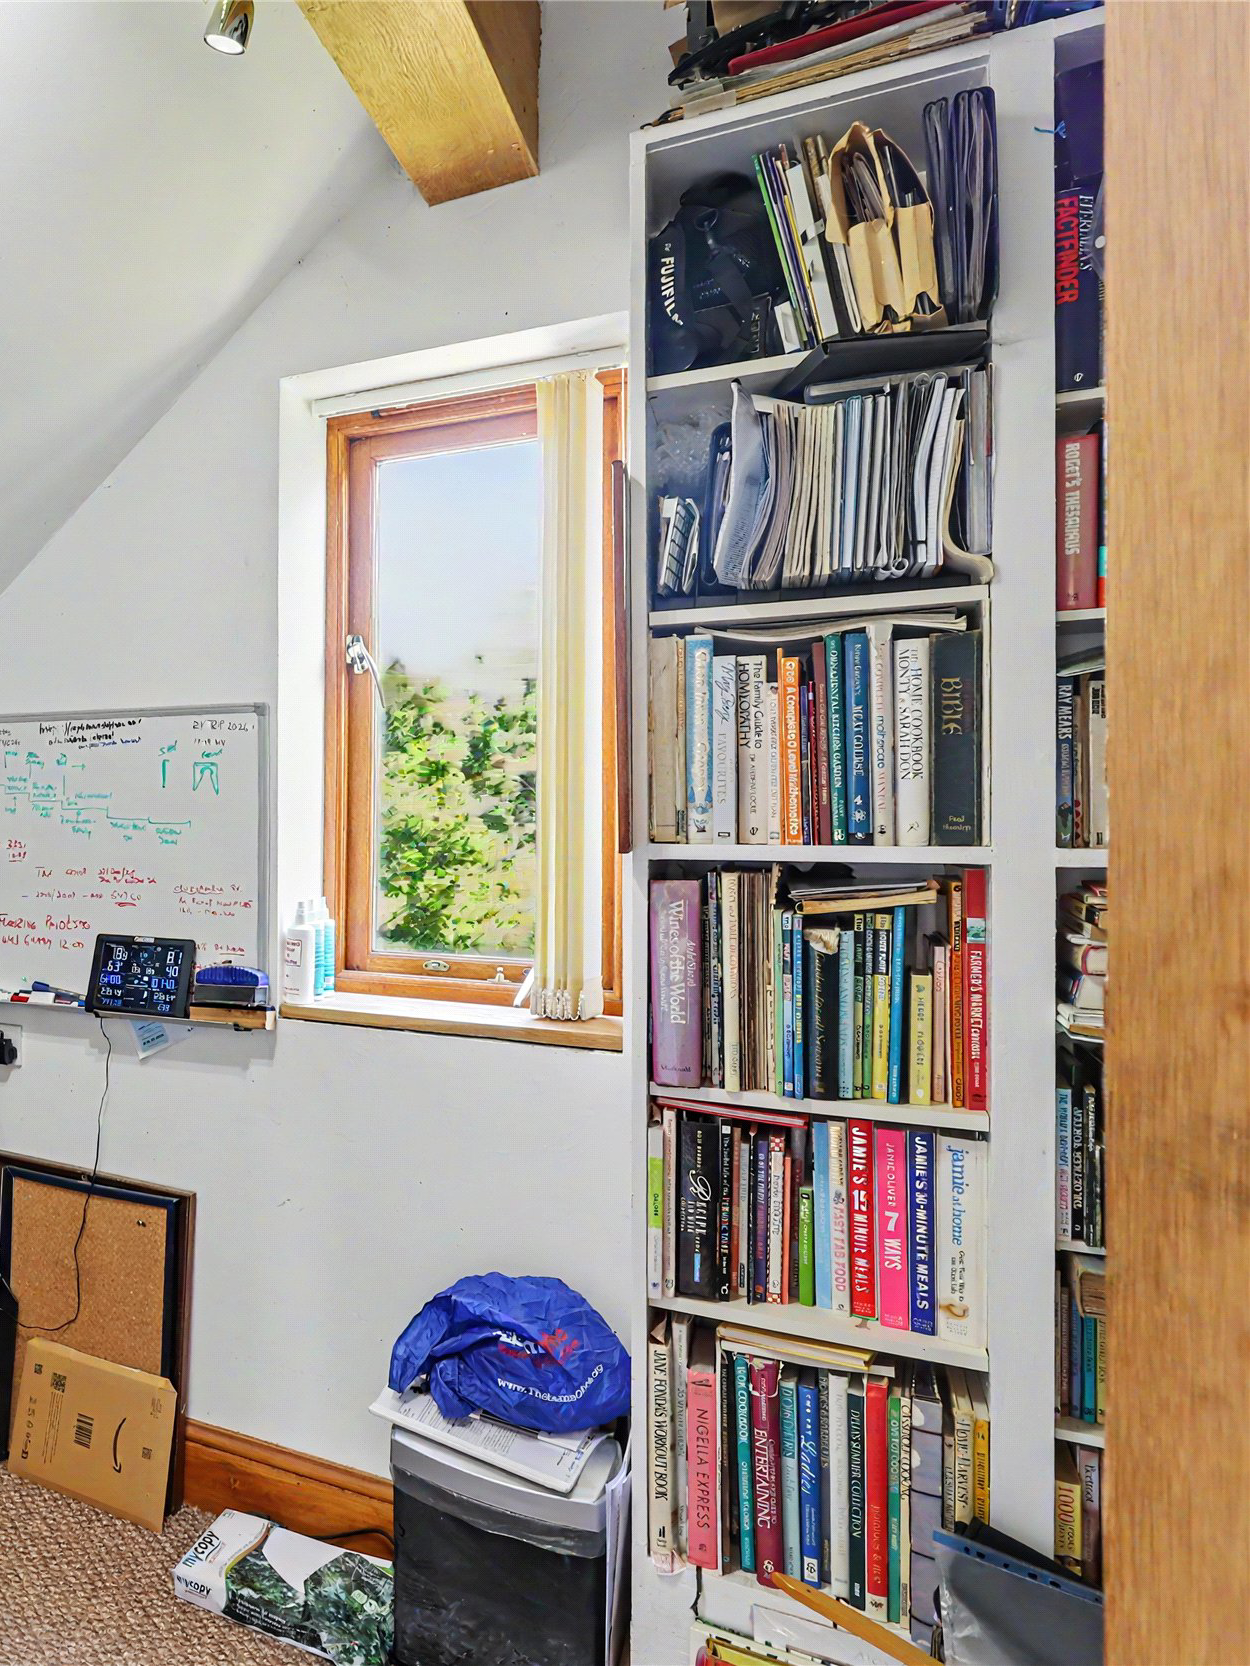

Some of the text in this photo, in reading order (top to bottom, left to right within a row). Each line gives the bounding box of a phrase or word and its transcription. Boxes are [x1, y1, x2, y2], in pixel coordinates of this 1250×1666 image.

[1055, 195, 1079, 305] FACTFINDER
[1065, 443, 1082, 555] ROGET'S THESAURUS
[753, 661, 762, 678] The
[898, 649, 910, 695] MONTY
[912, 667, 922, 705] HOME
[738, 663, 751, 749] HOMEOPATHY
[750, 680, 763, 709] Family
[940, 676, 964, 735] BIBLE
[1058, 685, 1071, 702] RAY
[753, 710, 763, 738] Guide
[899, 706, 911, 748] SARAH
[911, 709, 923, 779] COOKBOOK
[1058, 706, 1072, 739] MEARS
[717, 733, 727, 805] FAVOURITES
[900, 752, 911, 780] DON
[668, 899, 685, 943] Wines
[670, 944, 685, 958] of
[670, 983, 686, 1025] World
[970, 994, 982, 1028] MARKET
[852, 1127, 868, 1185] JAMIE'S
[946, 1145, 969, 1194] jamie
[884, 1143, 899, 1231] JAMIE OLIVER 7
[853, 1213, 868, 1254] MINUTE
[914, 1137, 929, 1310] JAMIE'S 30-MINUTE MEALS
[951, 1207, 966, 1246] home
[855, 1257, 870, 1294] MEALS
[884, 1238, 902, 1271] WAYS
[835, 1261, 846, 1292] FOOD
[653, 1350, 668, 1501] JANE FONDA'S WORKOUT BOOK
[737, 1391, 749, 1444] COOKBOOK
[696, 1408, 710, 1529] NIGELLA EXPRESS
[753, 1428, 771, 1529] ENTERTAINING
[800, 1435, 817, 1494] Ladies
[849, 1409, 862, 1538] DELIA'S SUMMER COLLECTION
[1057, 1486, 1075, 1523] 1000
[182, 1530, 220, 1568] mycopy
